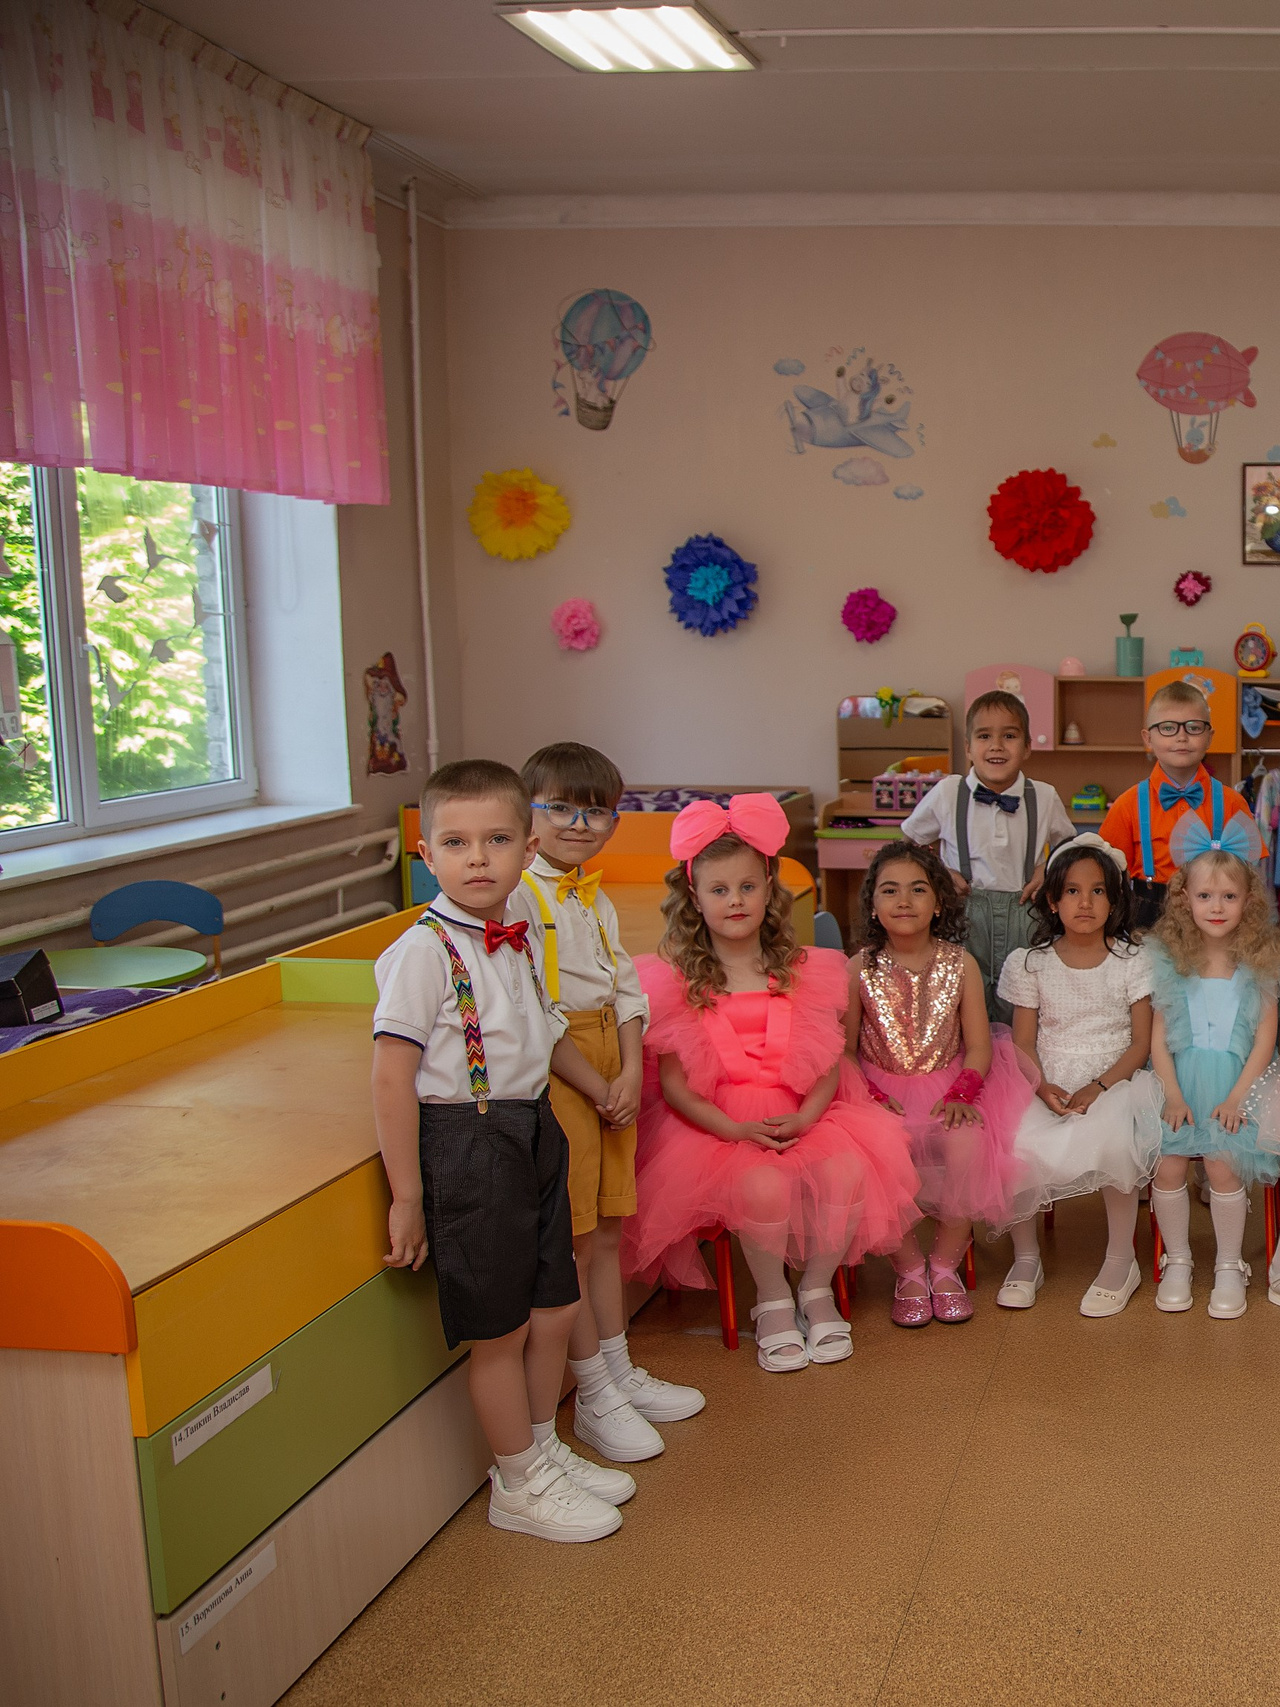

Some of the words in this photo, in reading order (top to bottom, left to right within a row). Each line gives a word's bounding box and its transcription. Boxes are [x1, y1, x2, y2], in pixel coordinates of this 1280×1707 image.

[212, 1385, 250, 1418] Владислав
[180, 1621, 192, 1638] 15.
[193, 1585, 233, 1626] Воронцова
[235, 1567, 253, 1589] Анна
